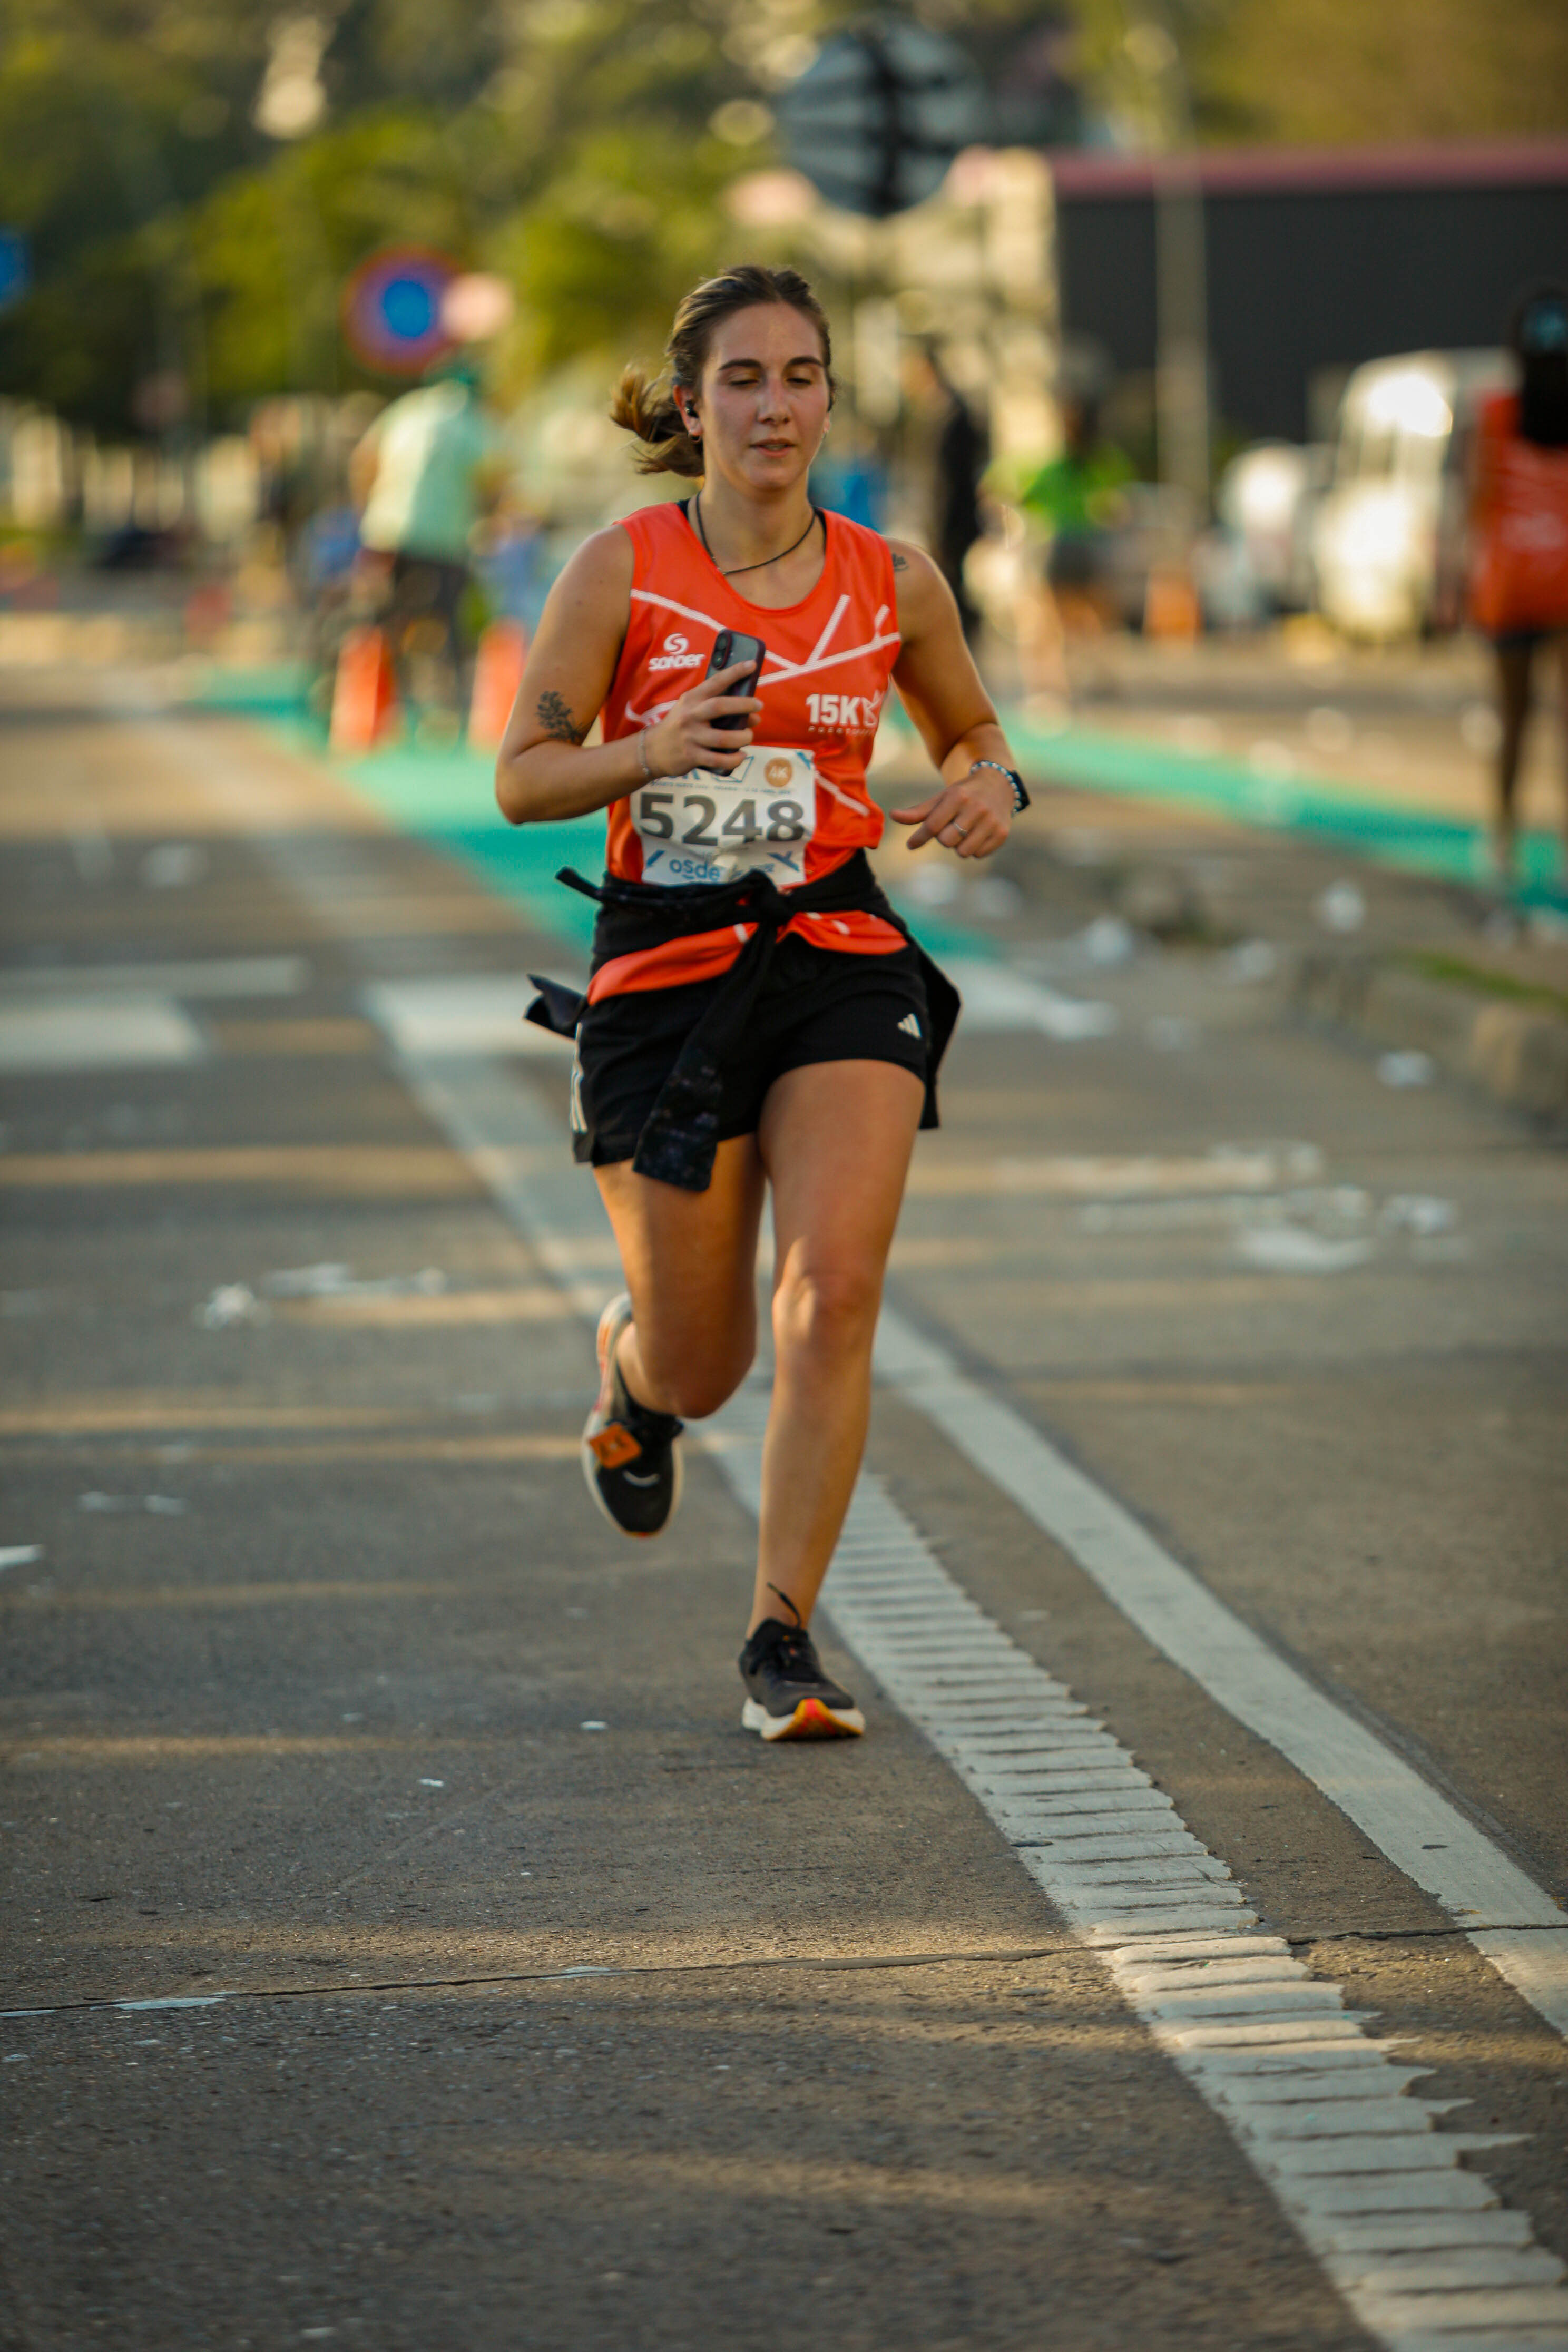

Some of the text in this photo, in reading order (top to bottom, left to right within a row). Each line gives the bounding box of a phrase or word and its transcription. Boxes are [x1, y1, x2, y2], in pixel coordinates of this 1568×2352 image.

[806, 693, 860, 726] 15K
[769, 766, 788, 779] 4K
[640, 792, 805, 846] 5248
[669, 859, 721, 882] osde
